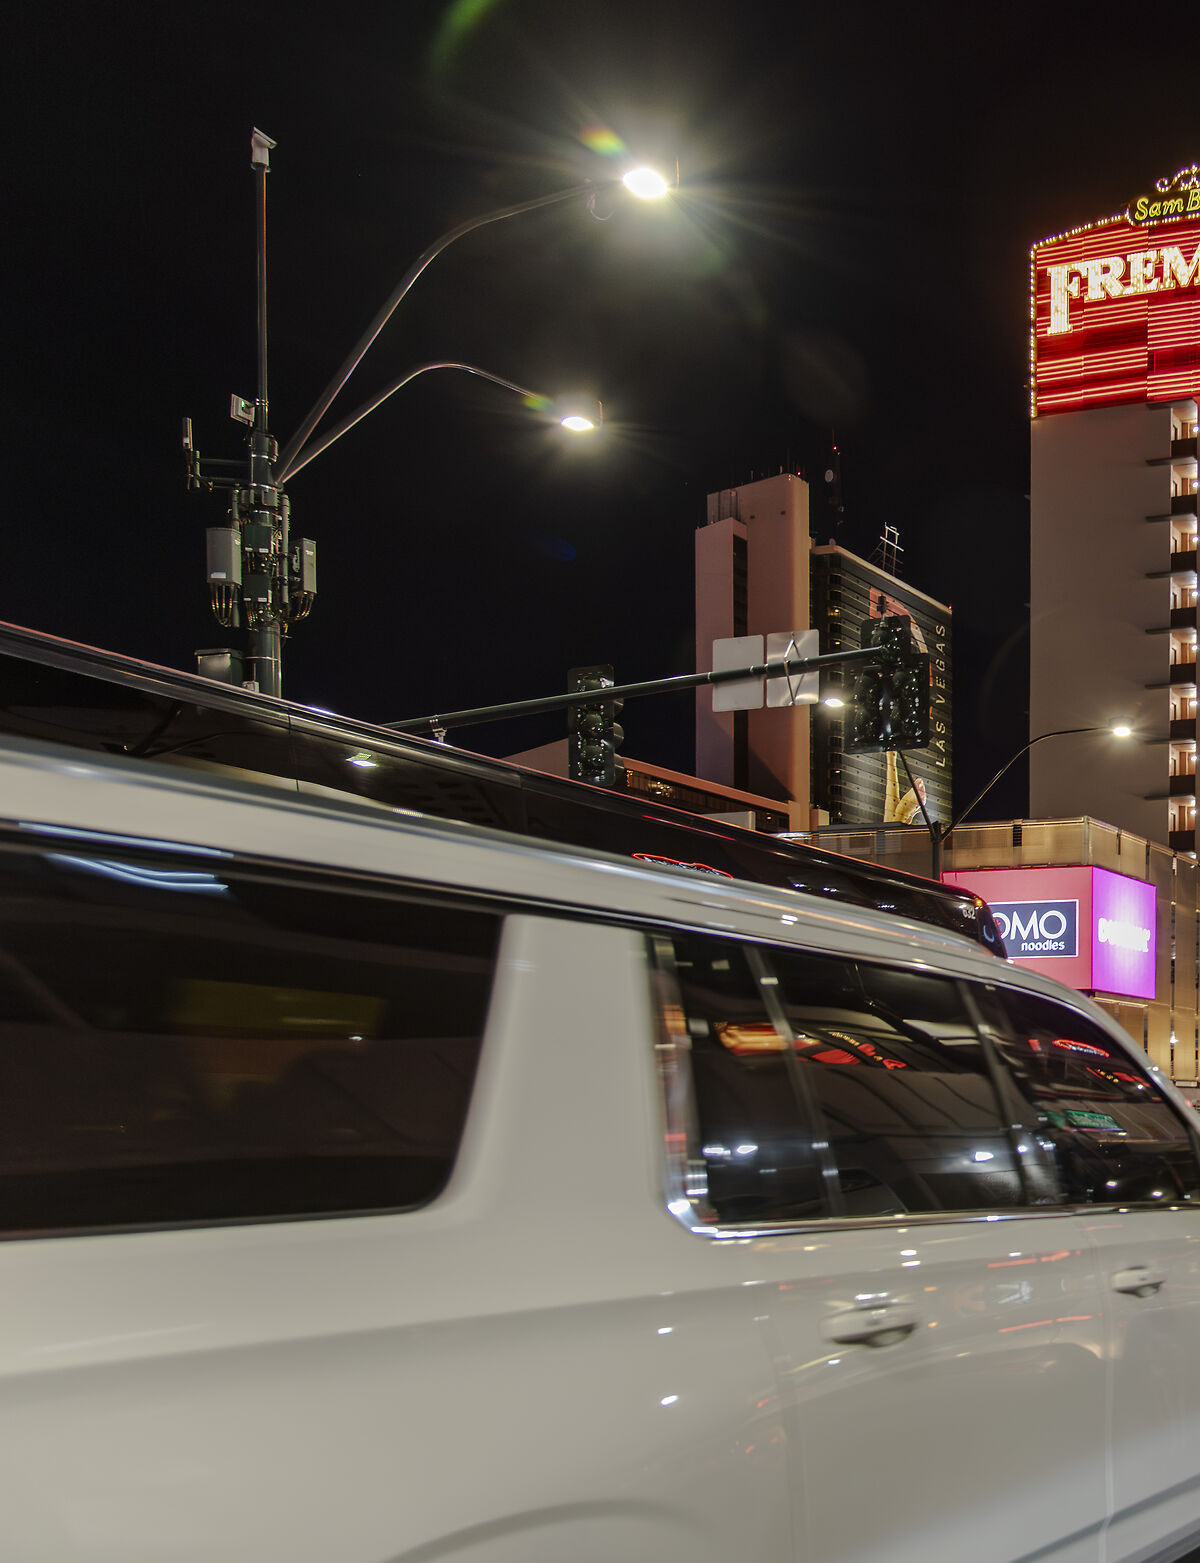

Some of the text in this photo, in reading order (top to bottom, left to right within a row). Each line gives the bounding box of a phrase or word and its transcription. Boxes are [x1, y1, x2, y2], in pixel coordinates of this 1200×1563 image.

[1135, 197, 1184, 221] Sam
[935, 625, 946, 768] LAS VEGAS
[1021, 939, 1065, 952] noodles
